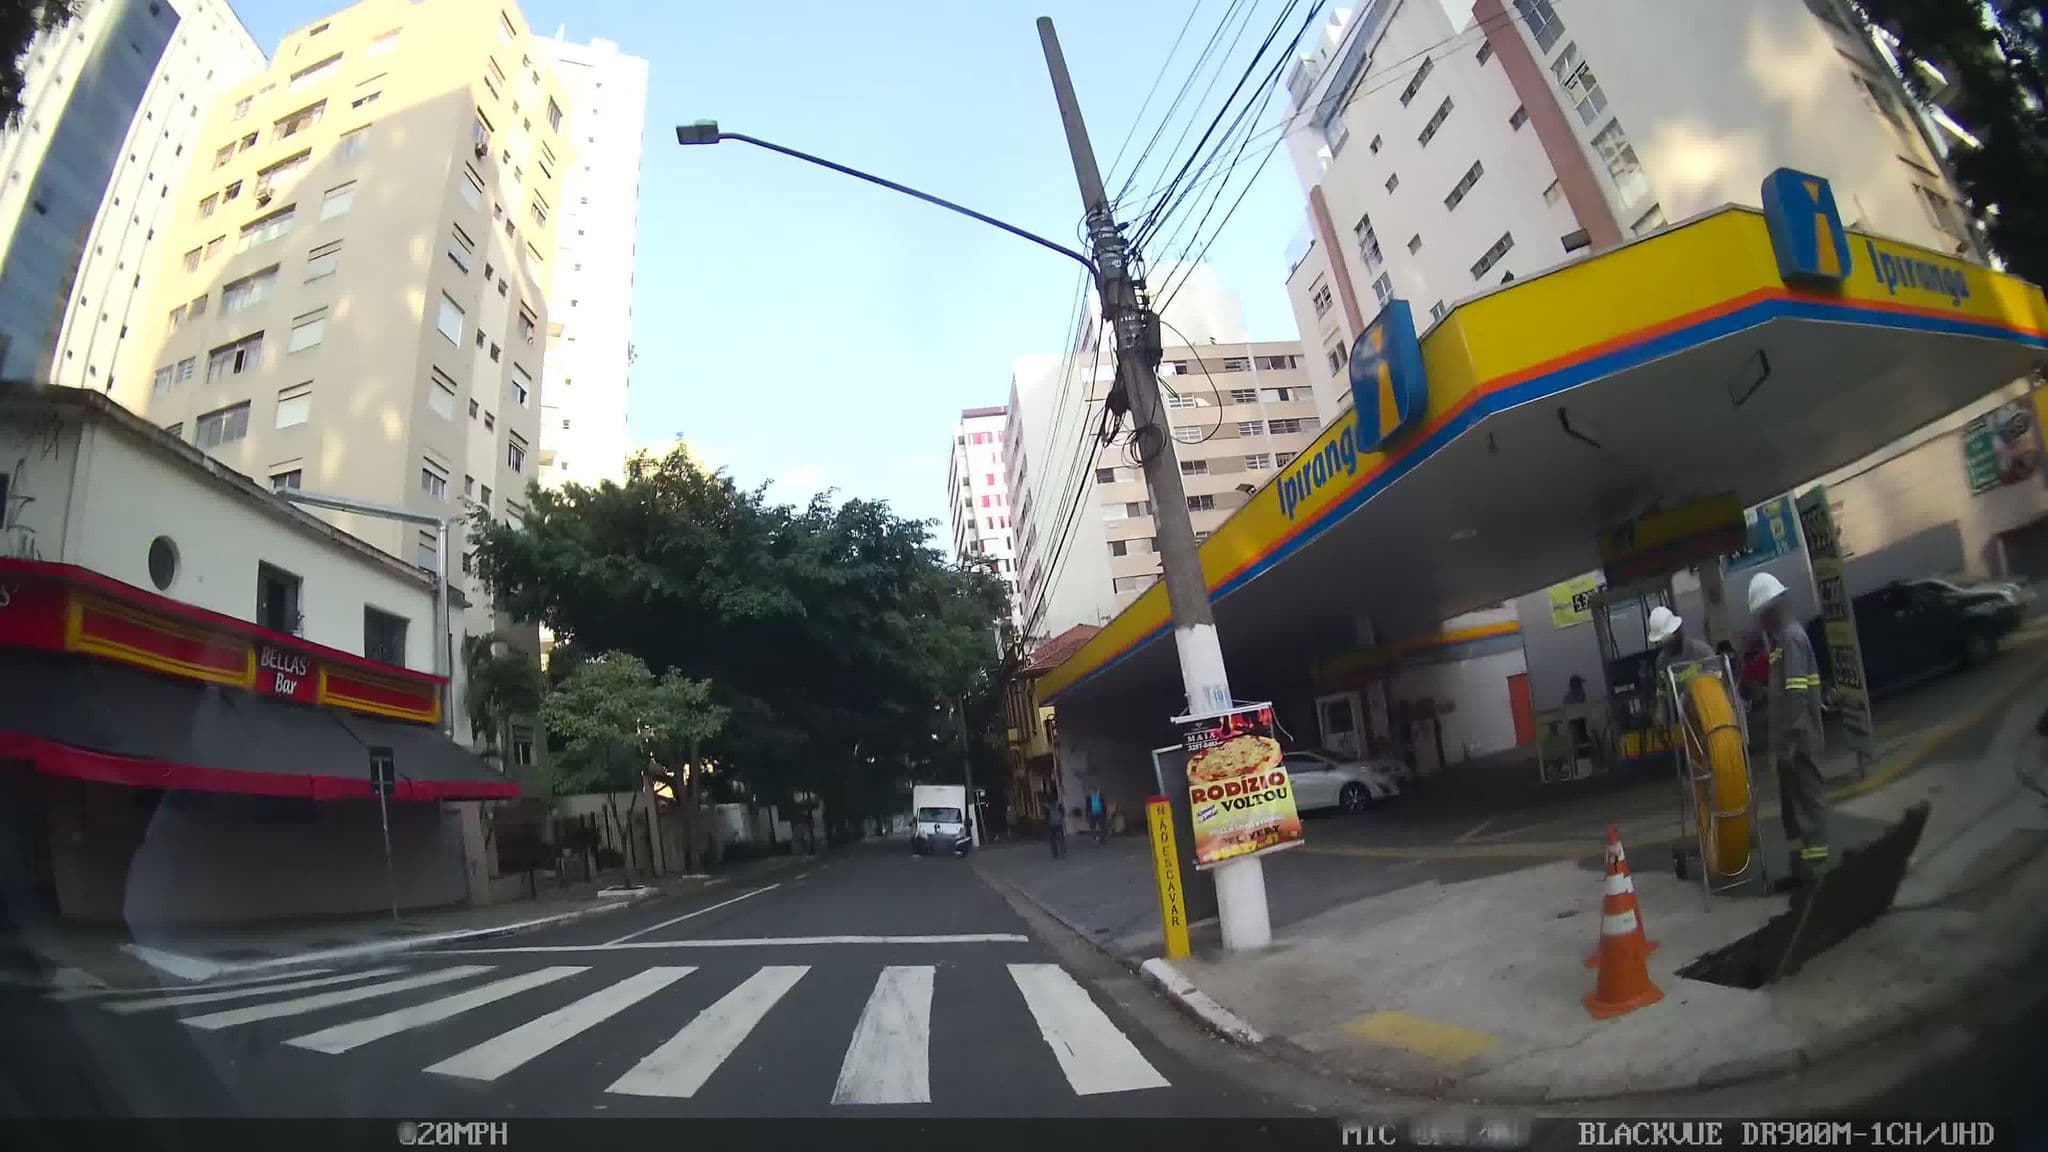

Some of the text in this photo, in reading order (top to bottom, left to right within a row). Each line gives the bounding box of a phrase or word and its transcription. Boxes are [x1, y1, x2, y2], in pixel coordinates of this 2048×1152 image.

[1866, 238, 1970, 306] Ipiranga
[1277, 425, 1357, 521] Ipirang
[275, 672, 297, 695] Bar
[1187, 731, 1217, 742] MAIA
[1191, 772, 1285, 804] RODÍZIO
[1221, 787, 1288, 813] VOLTOU
